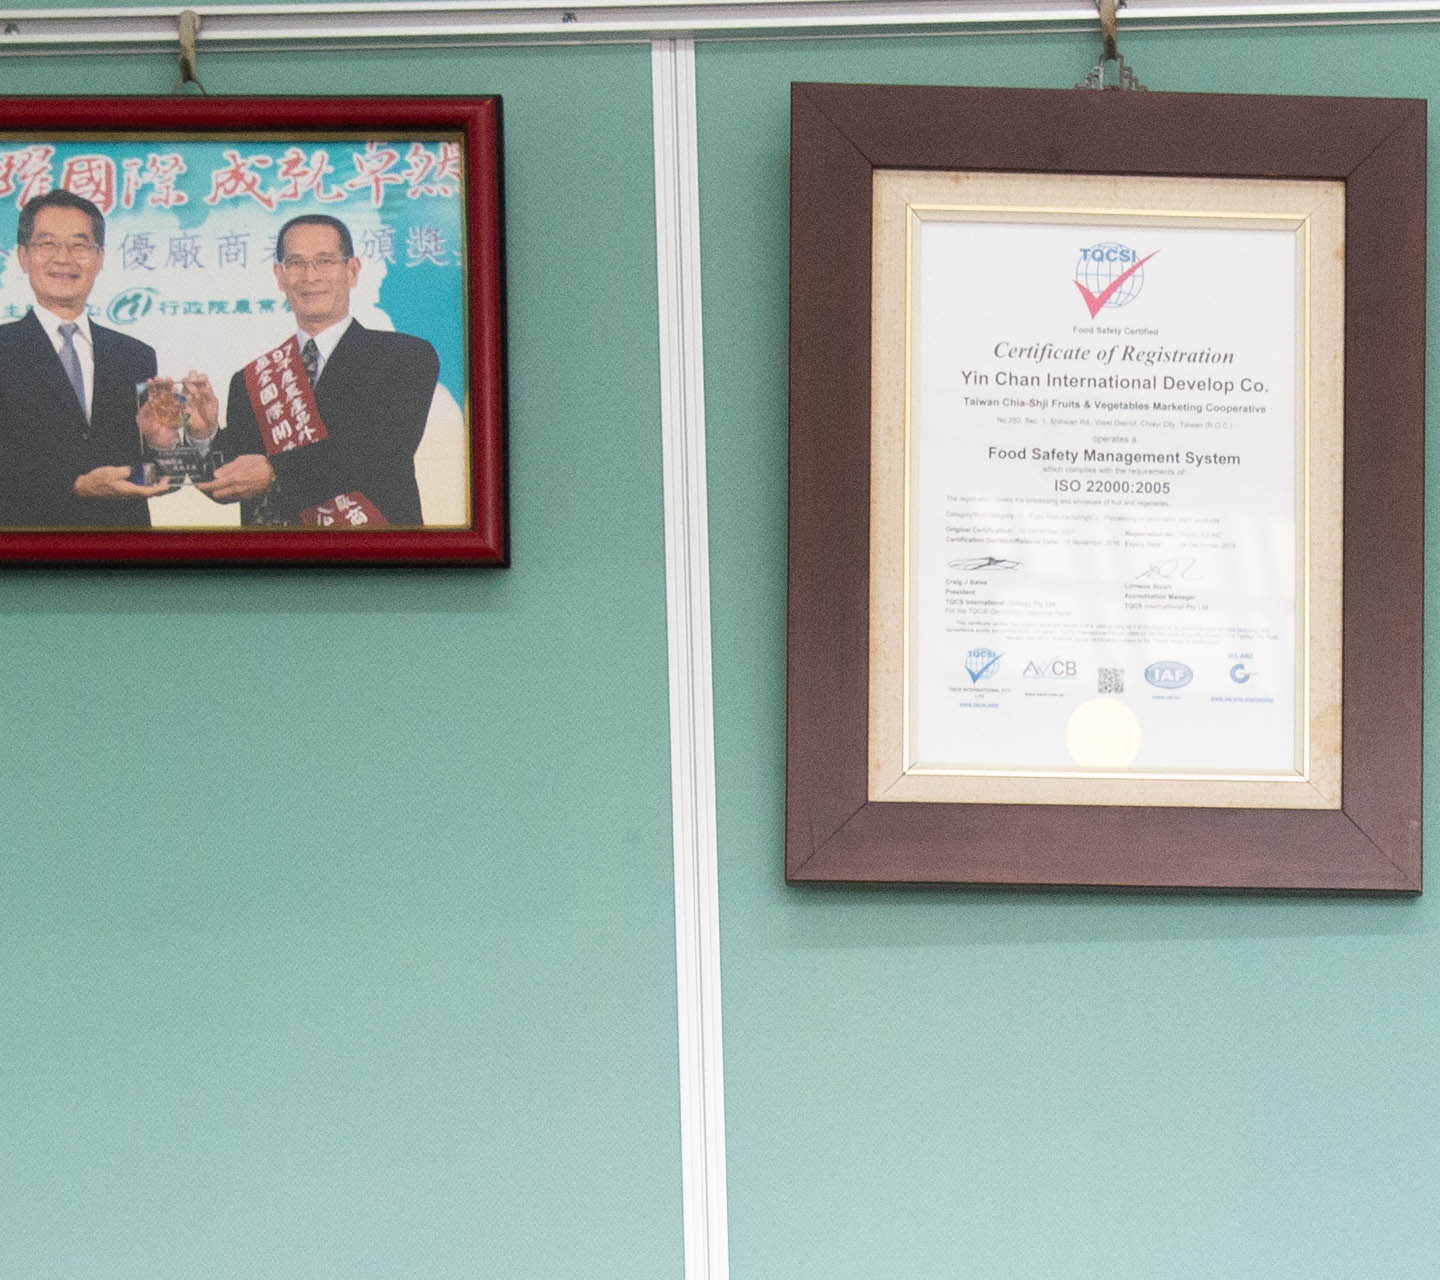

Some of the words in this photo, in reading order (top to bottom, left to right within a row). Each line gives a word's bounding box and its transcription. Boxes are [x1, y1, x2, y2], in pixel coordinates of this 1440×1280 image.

[204, 141, 460, 210] 成就卓然
[1080, 247, 1137, 263] TQCSI
[1072, 325, 1096, 334] Food
[1096, 326, 1122, 337] Safety
[1123, 327, 1159, 336] Certified
[994, 343, 1090, 363] Certificate
[1097, 346, 1115, 365] of
[1122, 346, 1233, 365] Registration
[962, 371, 988, 384] Yin
[996, 372, 1040, 386] Chan
[1048, 373, 1156, 389] International
[1164, 376, 1234, 395] Develop
[1241, 378, 1268, 392] Co.
[964, 396, 1000, 407] Taiwan
[1051, 399, 1081, 409] Fruits
[1083, 400, 1091, 409] &
[1094, 400, 1150, 412] Vegetables
[1152, 401, 1203, 414] Marketing
[1205, 403, 1266, 414] Cooperative
[988, 446, 1027, 460] Food
[1032, 448, 1078, 464] Safety
[1084, 449, 1179, 465] Management
[1186, 452, 1240, 467] System
[1054, 479, 1081, 492] ISO
[1087, 481, 1170, 494] 22000:2005
